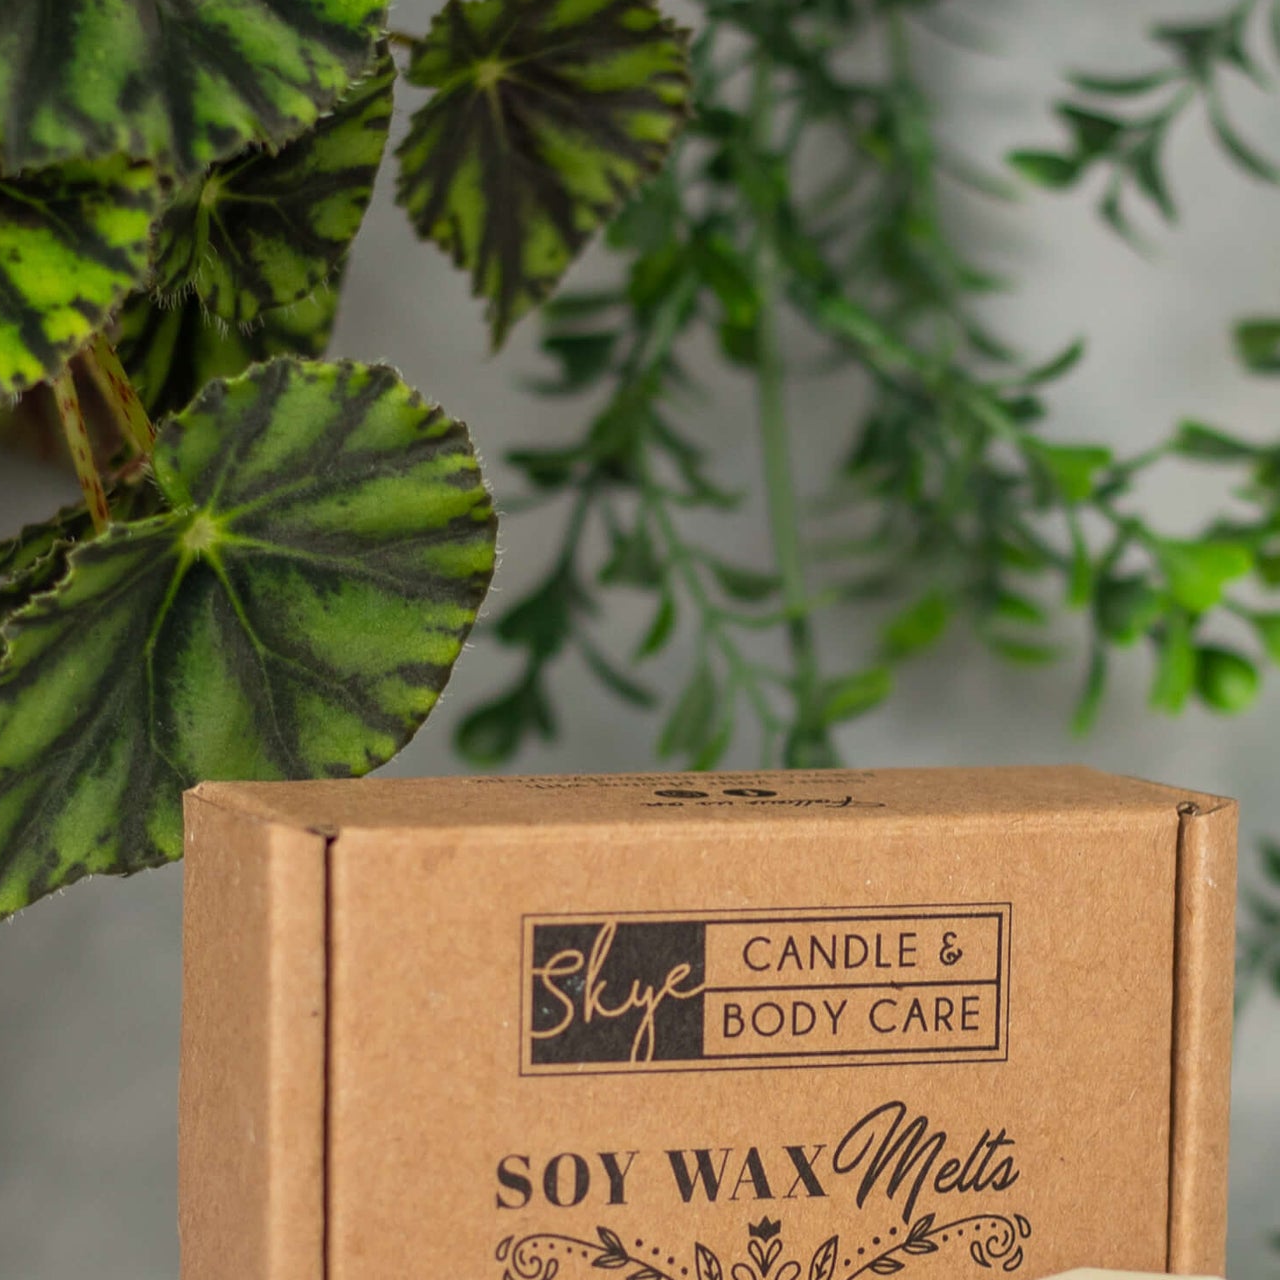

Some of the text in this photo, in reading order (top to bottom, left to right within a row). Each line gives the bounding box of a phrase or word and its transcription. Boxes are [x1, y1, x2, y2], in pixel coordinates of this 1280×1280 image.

[531, 920, 706, 1063] Skye
[743, 931, 963, 971] CANDLE &
[723, 995, 980, 1038] BODY CARE
[496, 1100, 1019, 1223] SOY WAX Melts
